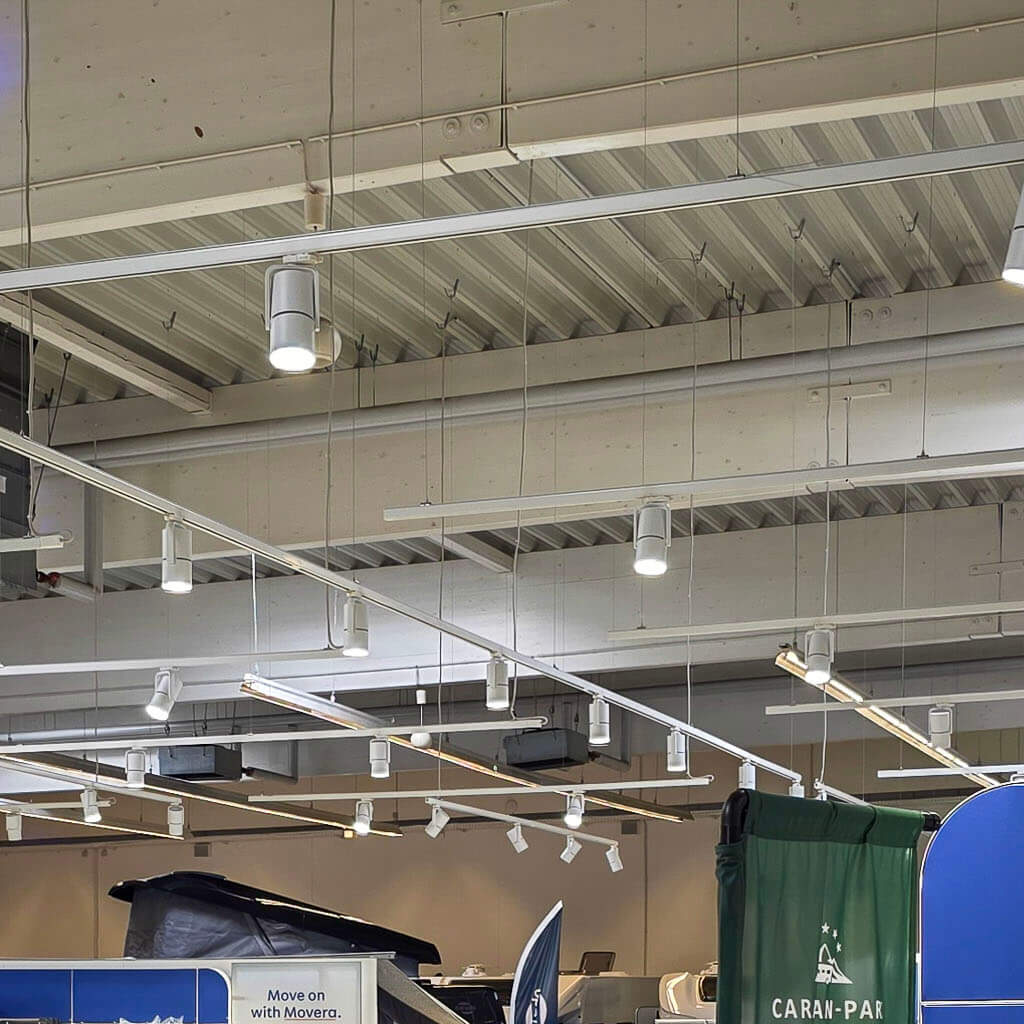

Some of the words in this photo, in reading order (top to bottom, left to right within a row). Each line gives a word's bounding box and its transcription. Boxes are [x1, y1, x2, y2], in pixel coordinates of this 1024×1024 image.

[268, 990, 304, 1001] Move
[308, 992, 325, 1001] on
[251, 1006, 280, 1018] with
[284, 1007, 341, 1018] Movera.
